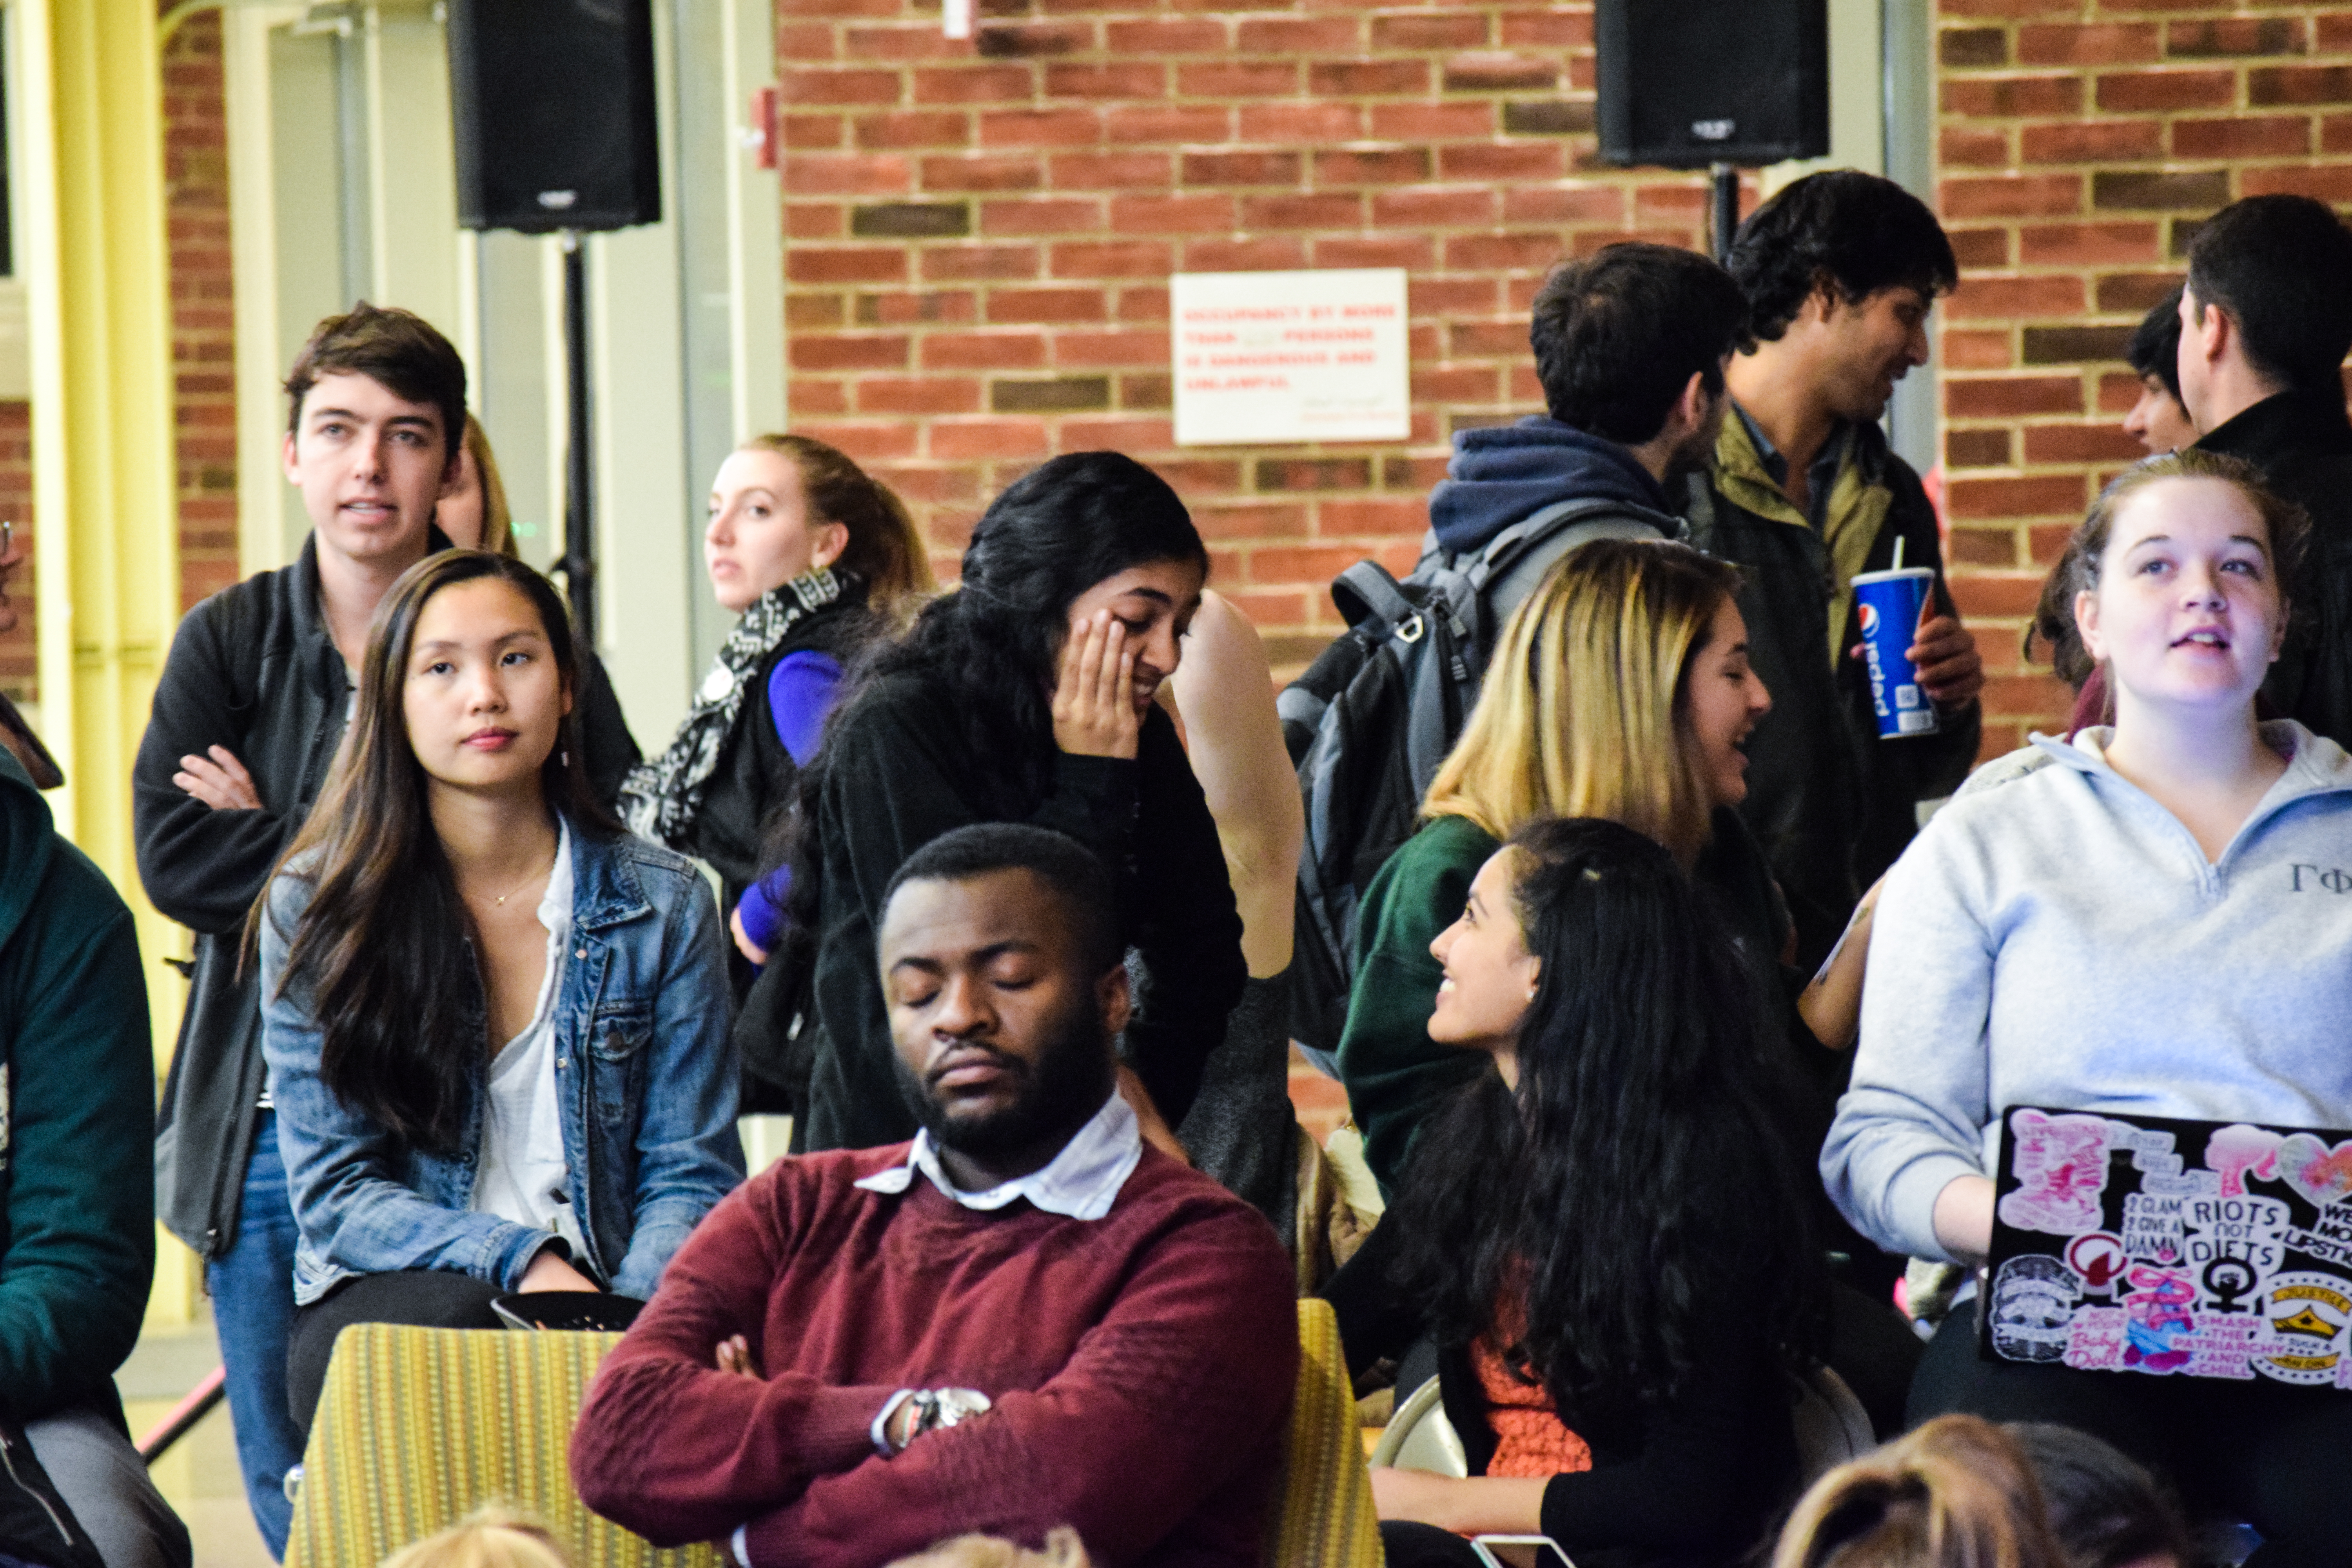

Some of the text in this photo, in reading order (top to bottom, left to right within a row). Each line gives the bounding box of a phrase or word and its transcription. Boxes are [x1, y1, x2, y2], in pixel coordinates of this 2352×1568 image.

[2195, 1200, 2279, 1226] RIOTS
[2192, 1239, 2274, 1266] DIETS
[2198, 1315, 2261, 1329] SMASH
[2213, 1328, 2244, 1340] THE
[2173, 1337, 2285, 1354] PATRIARCHY
[2208, 1353, 2245, 1364] AND
[2198, 1363, 2250, 1377] CHILL
